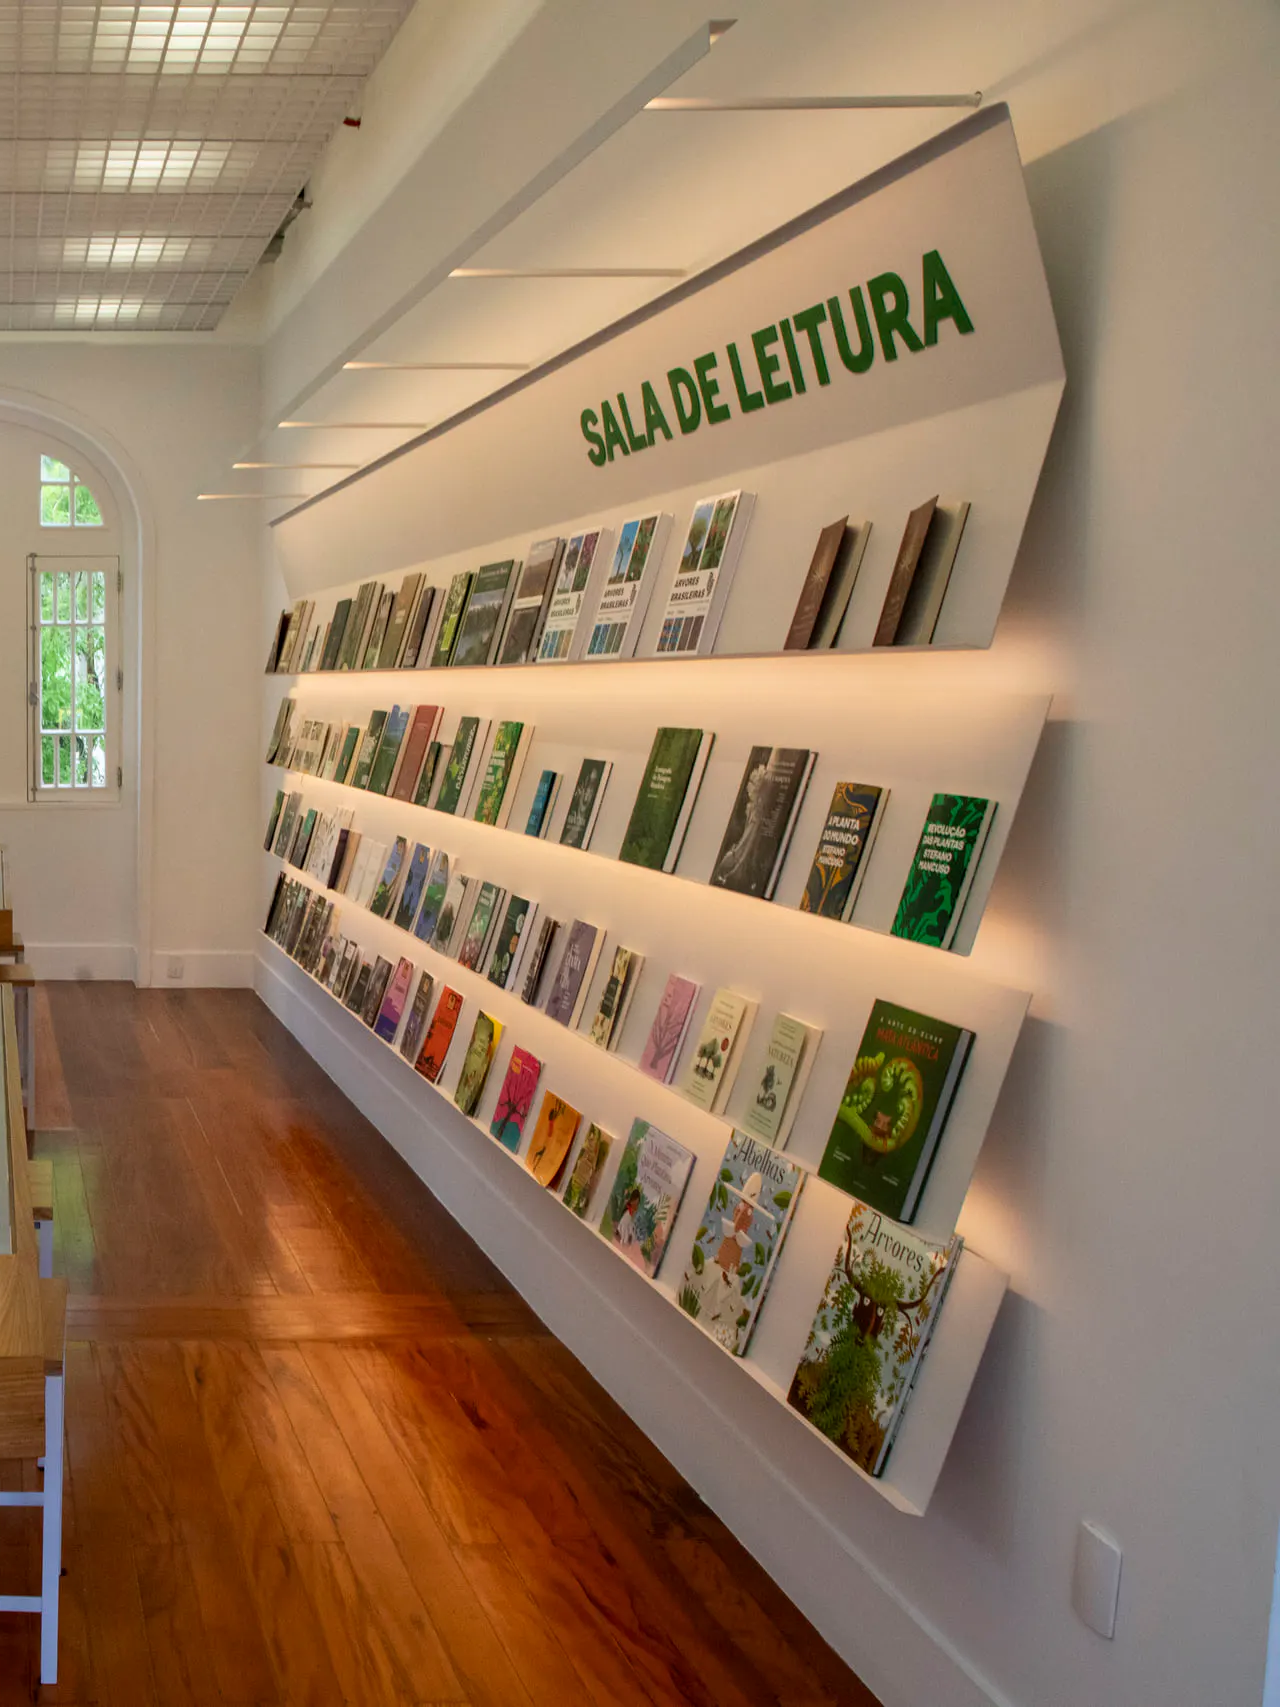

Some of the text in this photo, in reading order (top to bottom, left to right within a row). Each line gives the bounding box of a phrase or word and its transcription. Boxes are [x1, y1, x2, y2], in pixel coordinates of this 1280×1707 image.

[580, 249, 975, 467] SALA DE LEITURA
[832, 816, 860, 830] PLANTA
[831, 831, 859, 845] MUNDO
[932, 836, 965, 850] PLANTAS
[733, 1136, 785, 1184] Abelhas
